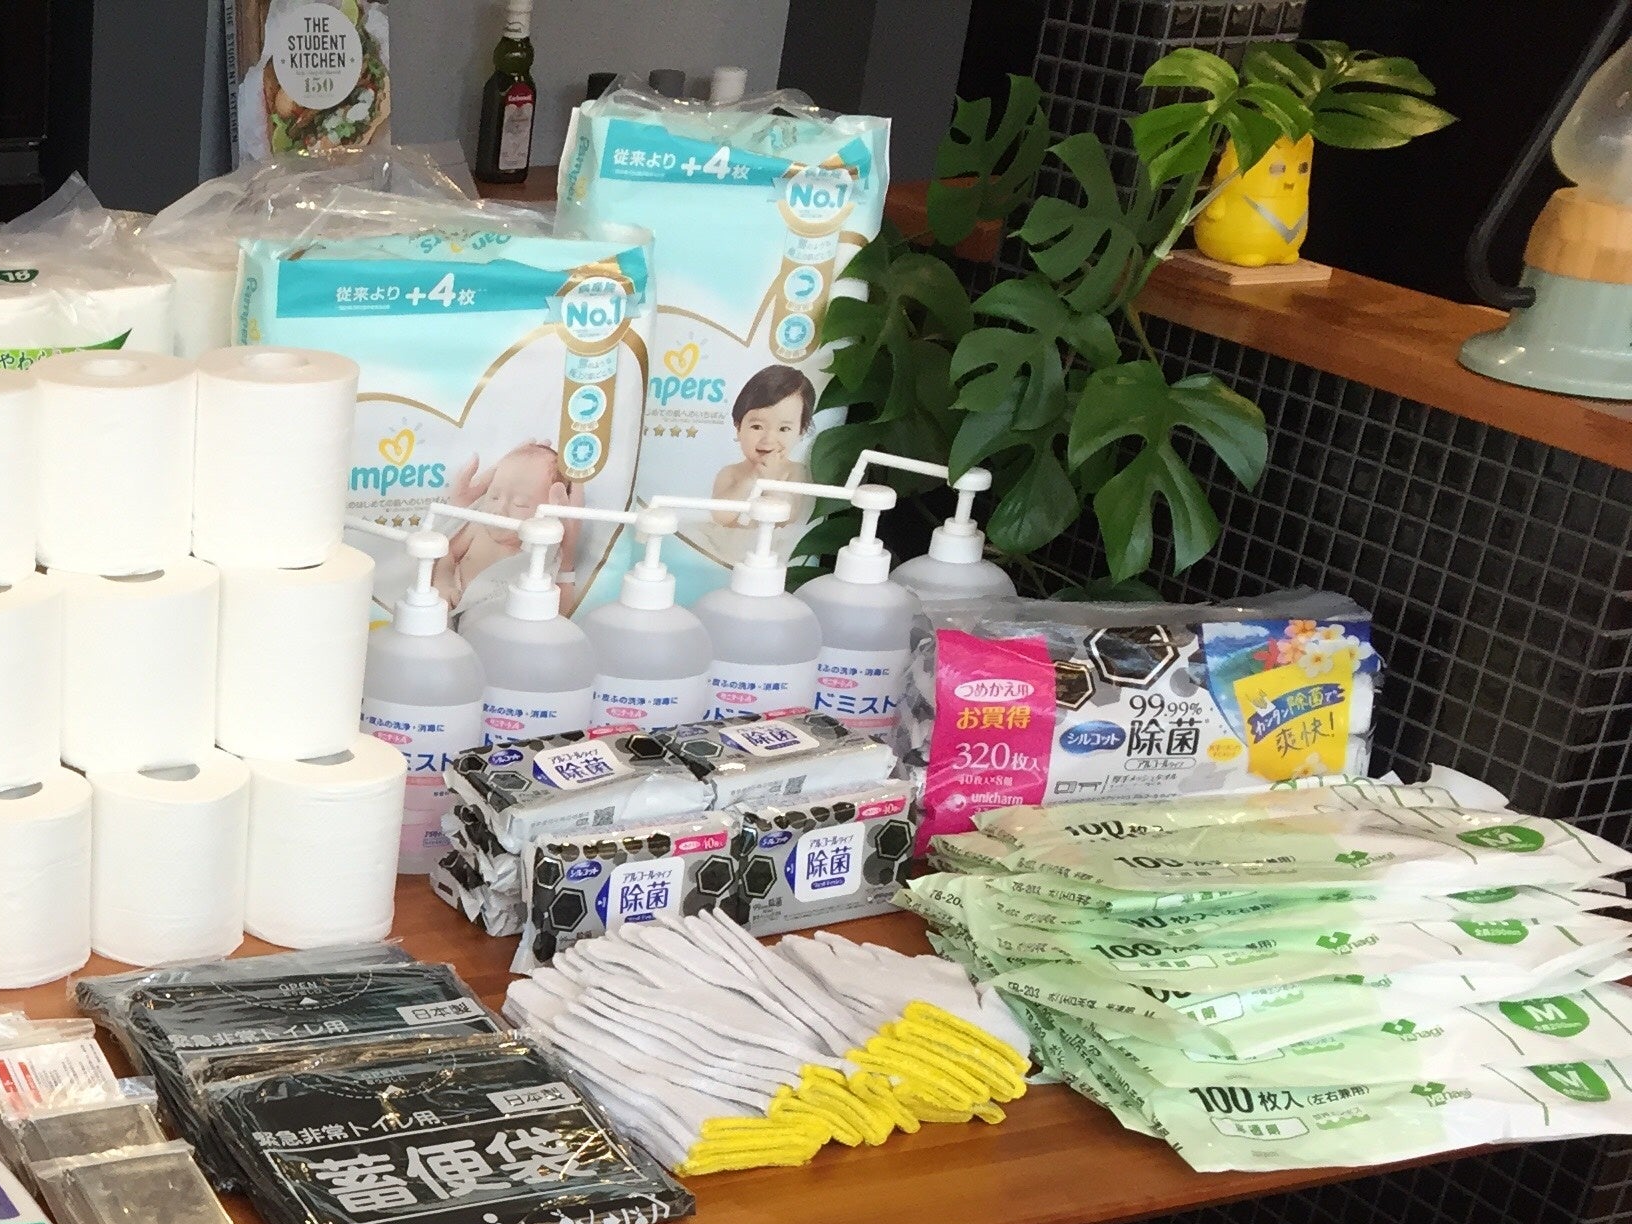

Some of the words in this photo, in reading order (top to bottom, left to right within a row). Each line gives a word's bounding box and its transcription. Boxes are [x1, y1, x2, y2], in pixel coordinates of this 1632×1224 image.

[304, 17, 329, 33] THE
[287, 34, 346, 51] STUDENT
[290, 52, 346, 68] KITCHEN
[613, 148, 676, 169] 従来より
[789, 184, 847, 209] No.1
[336, 285, 401, 303] 従来より
[566, 300, 623, 328] No.1
[959, 681, 1030, 699] つめかえ用
[955, 706, 1032, 730] お買得
[1128, 693, 1203, 719] 99.99%
[1065, 732, 1121, 749] シルコット
[1127, 720, 1203, 757] 除菌
[1276, 722, 1334, 754] 爽快!
[952, 743, 1039, 772] 320枚入
[556, 757, 616, 785] 除菌
[971, 792, 1024, 806] unicharm
[806, 848, 851, 880] 除菌
[619, 882, 670, 914] 除菌
[410, 1003, 472, 1022] 日本製
[1525, 1001, 1558, 1022] M
[167, 1017, 350, 1049] 緊急非常トイレ用
[502, 1087, 567, 1108] 日本製
[252, 1109, 443, 1149] 緊急非常トイレ用
[314, 1126, 598, 1216] 蓄便袋
